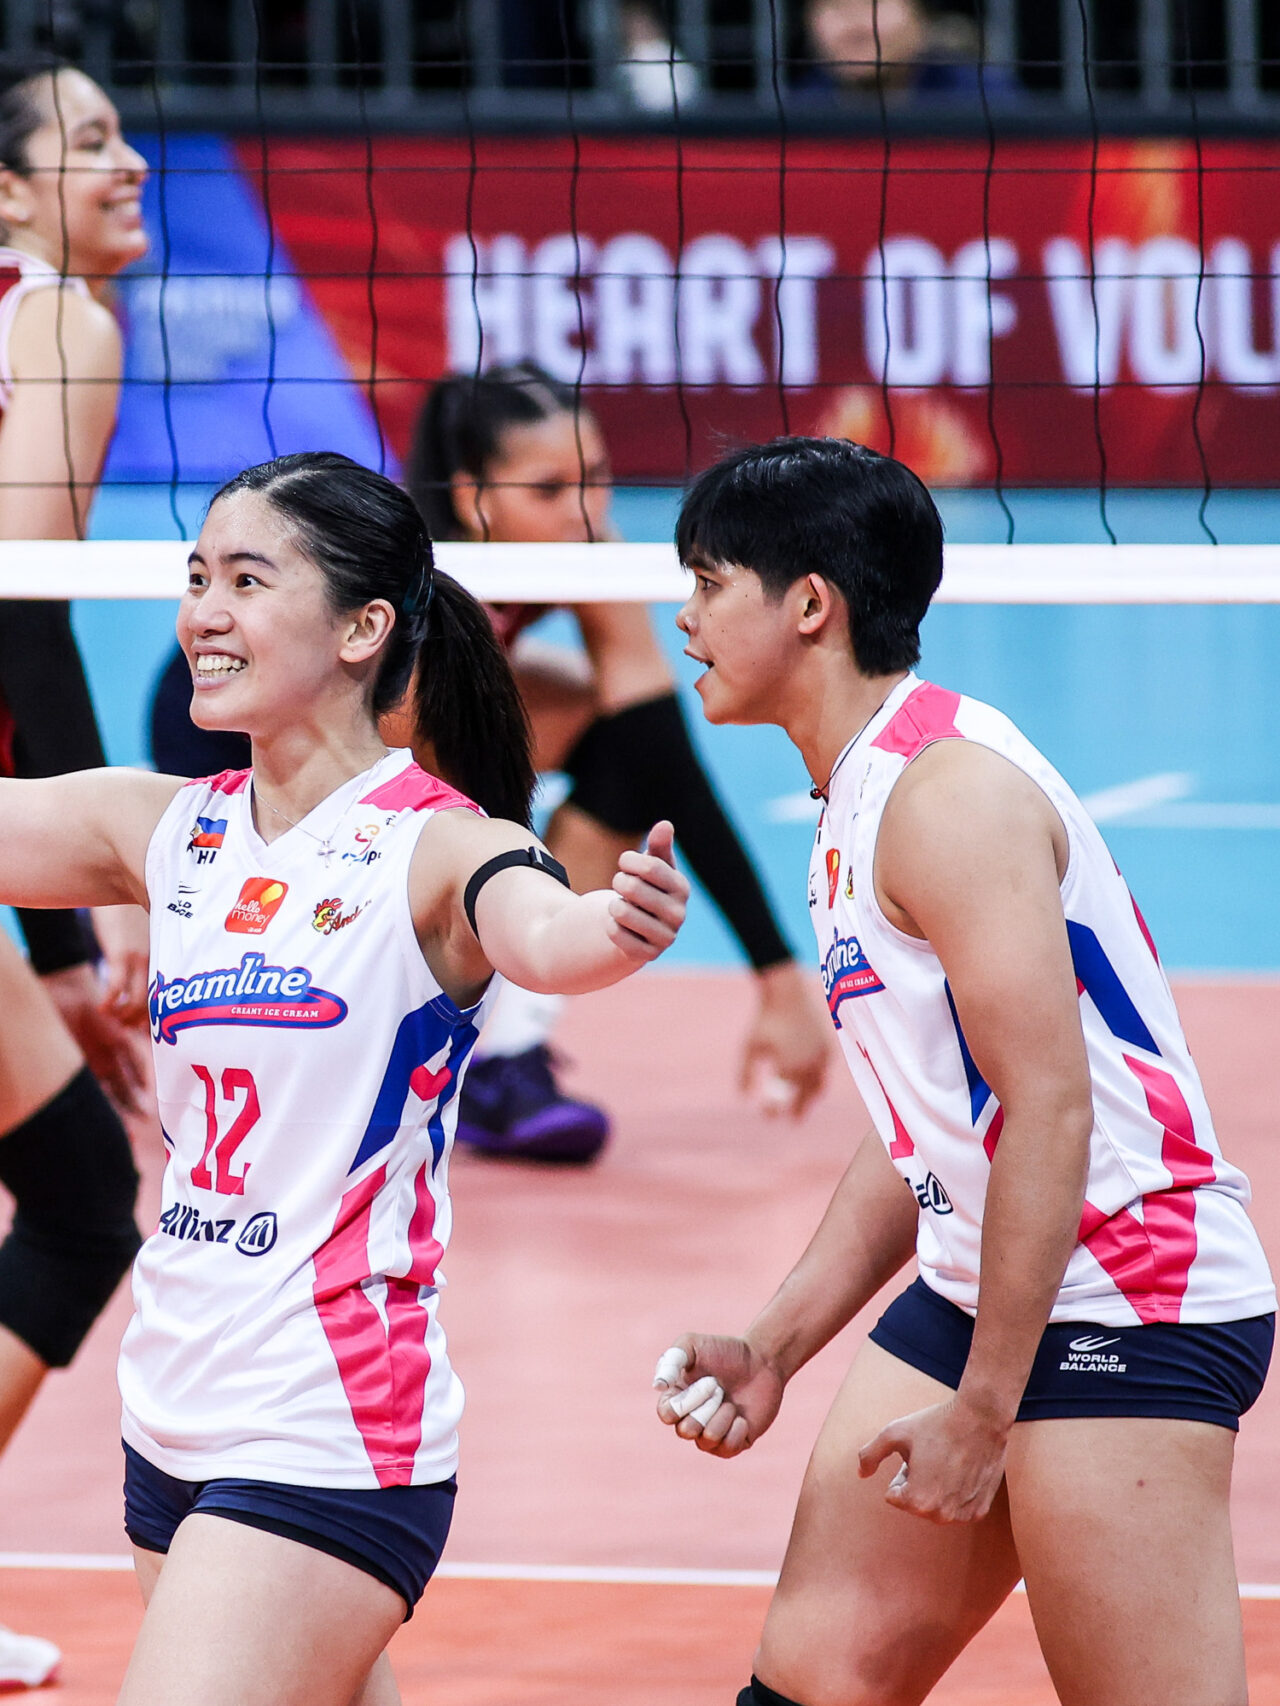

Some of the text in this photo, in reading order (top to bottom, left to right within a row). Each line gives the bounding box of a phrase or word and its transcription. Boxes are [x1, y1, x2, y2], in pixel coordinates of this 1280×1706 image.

[443, 233, 836, 392] HEART
[862, 235, 1020, 393] OF
[1042, 235, 1280, 395] VOL
[234, 898, 262, 913] hello
[231, 910, 270, 928] money
[231, 1006, 319, 1018] CREAMY ICE CREAM
[190, 1063, 261, 1196] 12
[1068, 1353, 1120, 1363] WORLD
[1059, 1361, 1127, 1373] BALANCE
